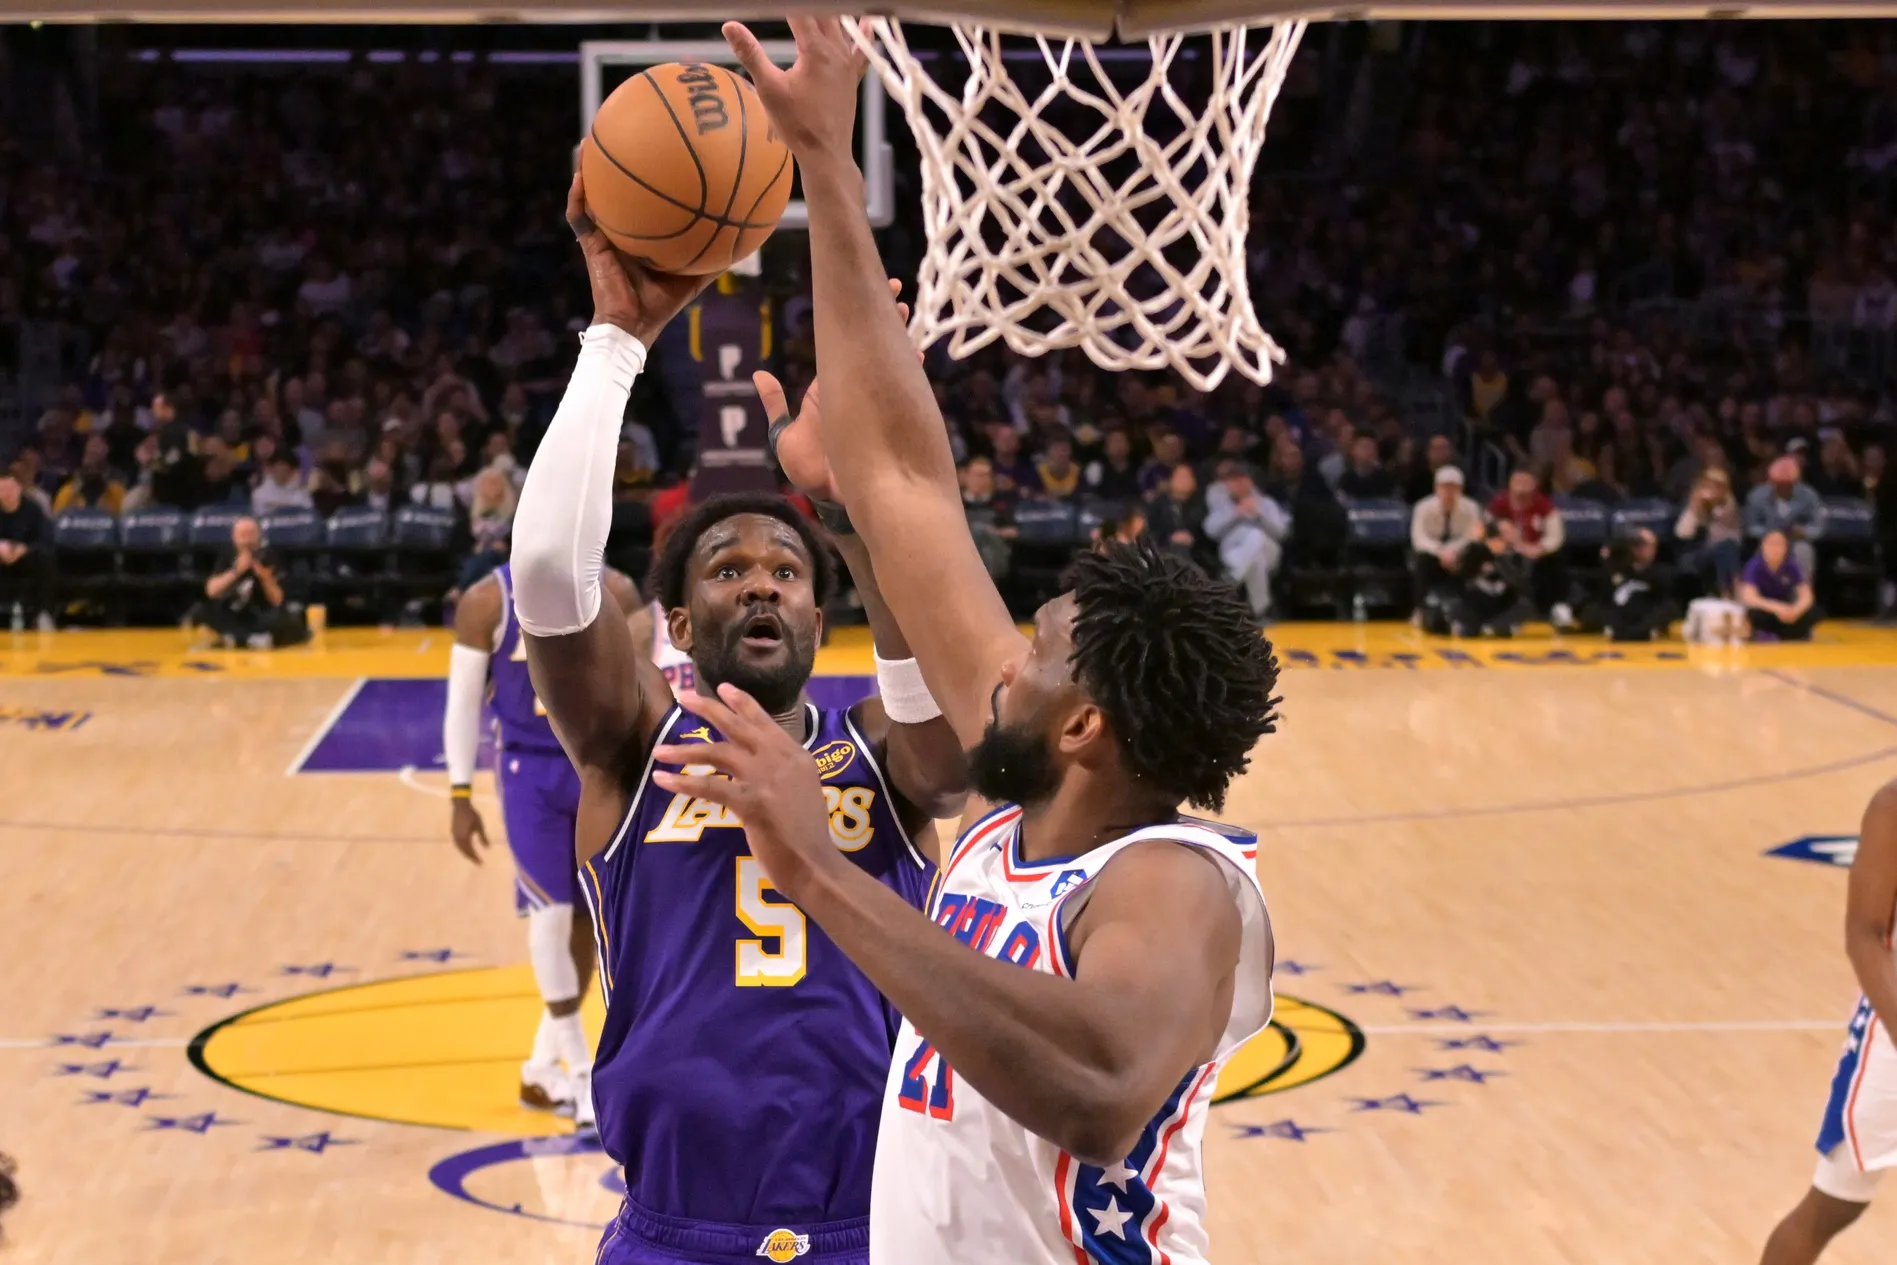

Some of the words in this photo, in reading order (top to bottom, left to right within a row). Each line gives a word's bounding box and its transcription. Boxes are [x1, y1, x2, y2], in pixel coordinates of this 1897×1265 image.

[815, 745, 851, 768] bigo
[736, 856, 807, 987] 5
[758, 1237, 809, 1255] LAKERS
